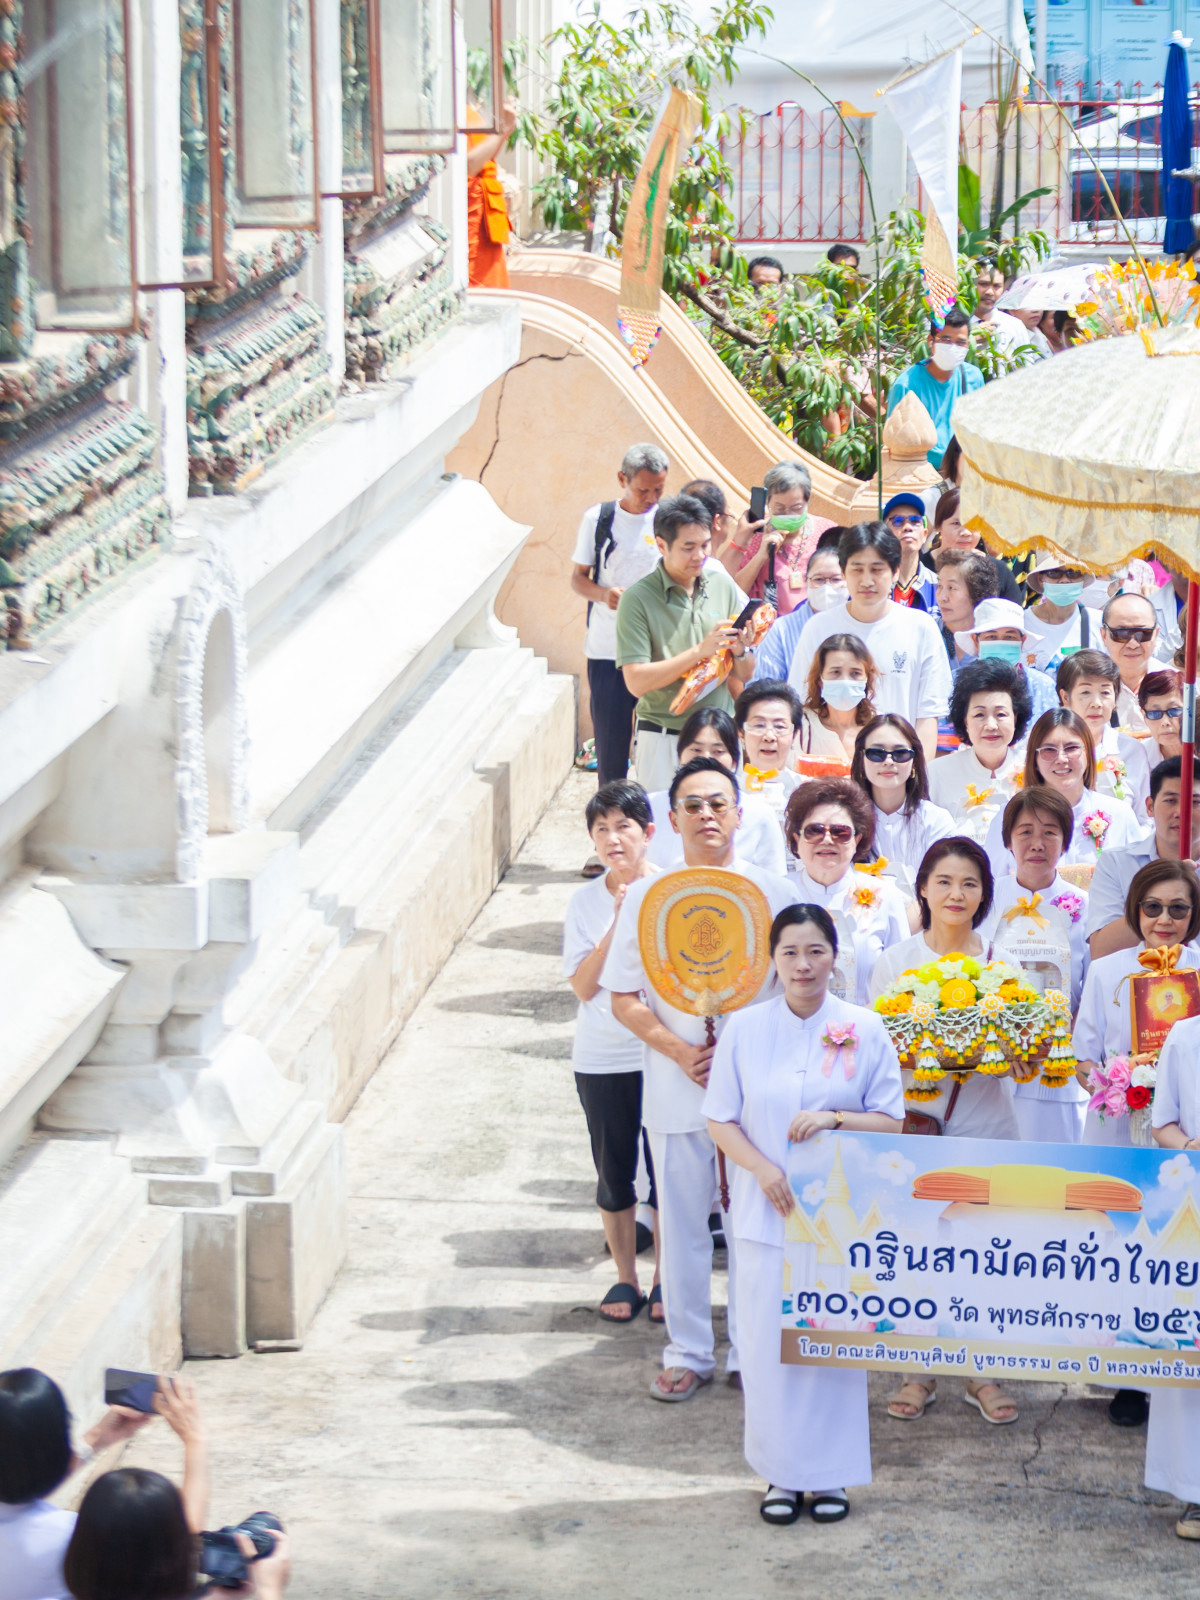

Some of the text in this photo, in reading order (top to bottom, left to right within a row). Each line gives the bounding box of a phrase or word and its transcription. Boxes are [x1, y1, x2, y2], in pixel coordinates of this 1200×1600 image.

[849, 1231, 1199, 1286] กฐินสามัคคีทั่วไทย
[797, 1291, 938, 1320] ๓๐,๐๐๐
[949, 1296, 979, 1323] วัด
[988, 1302, 1121, 1334] พุทธศักราช
[800, 1338, 831, 1356] โดย
[837, 1344, 966, 1367] คณะศิษยานุศิษย์
[973, 1354, 1051, 1371] บูชาธรรม
[1057, 1360, 1081, 1372] ๘๑
[1088, 1355, 1099, 1373] ปี
